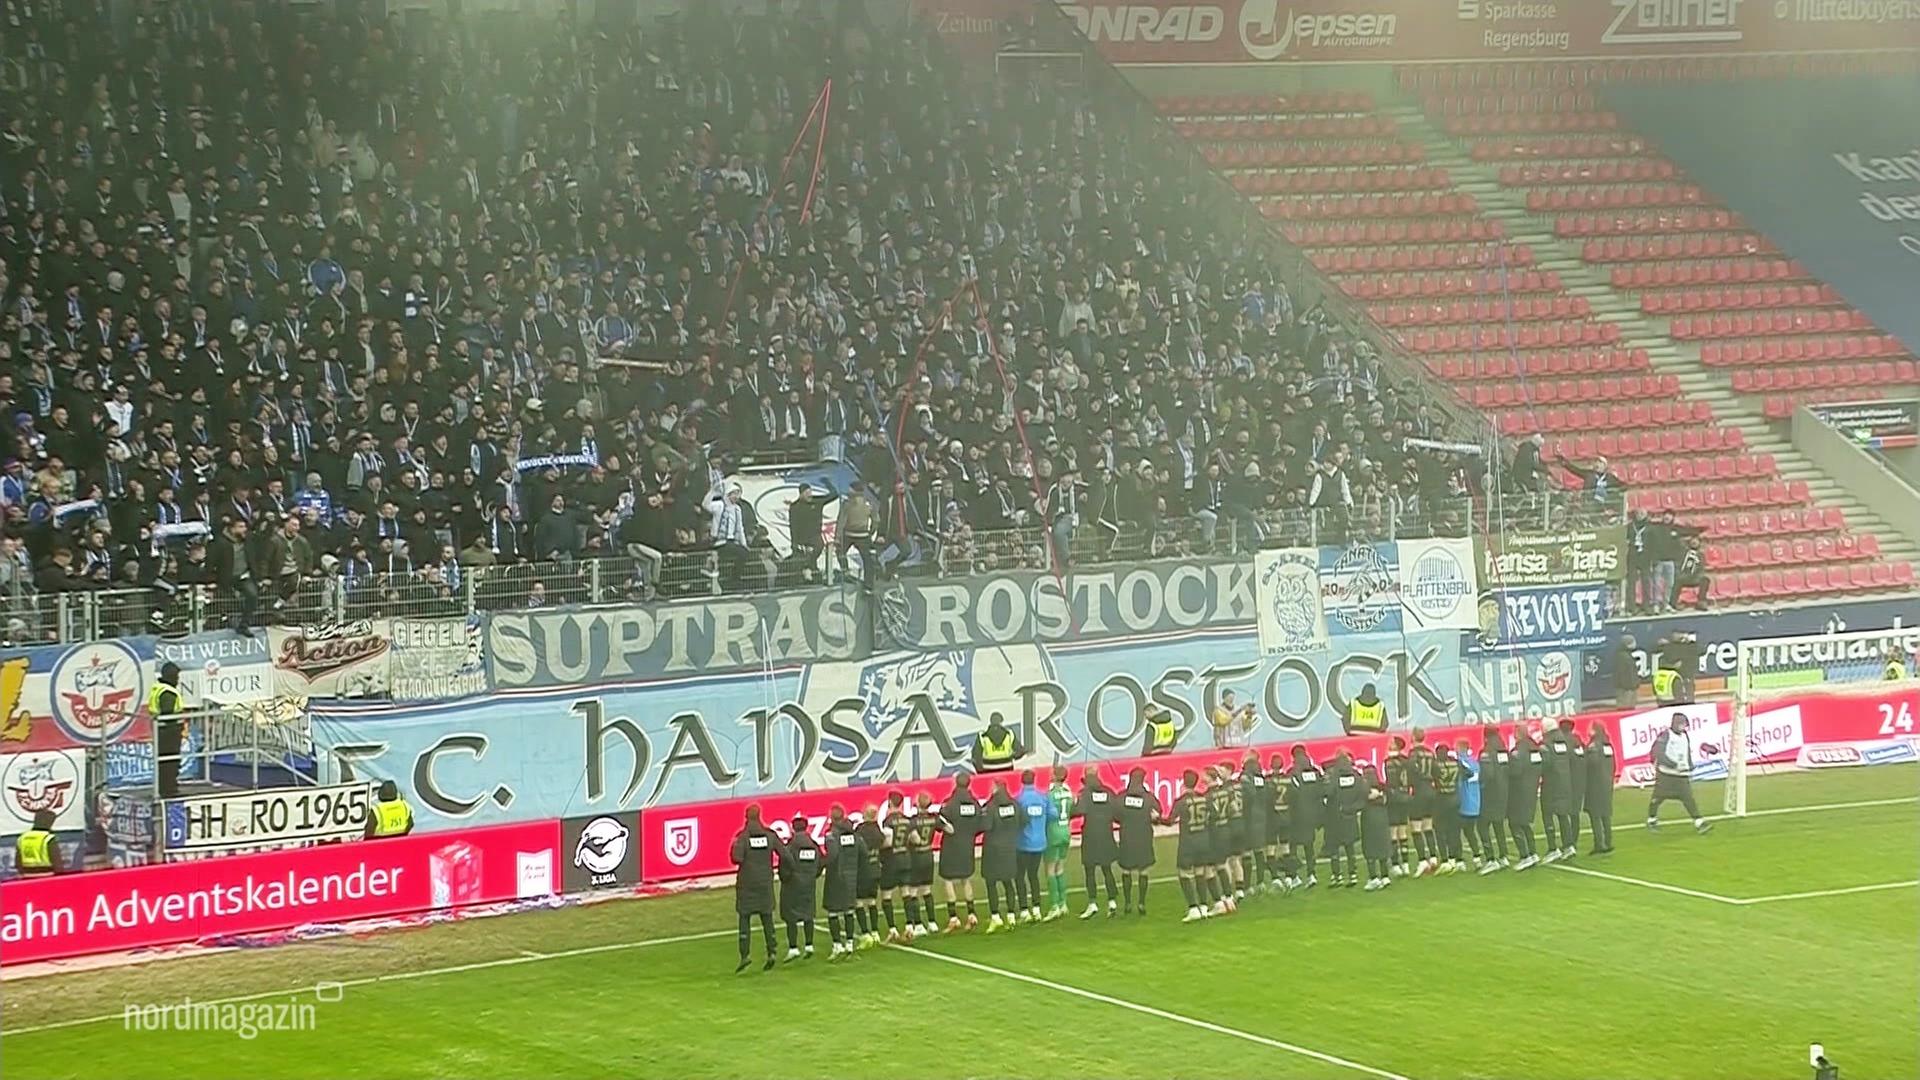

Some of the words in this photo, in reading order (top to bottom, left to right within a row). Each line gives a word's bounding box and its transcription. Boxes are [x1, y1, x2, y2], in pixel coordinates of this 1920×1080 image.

[1485, 1, 1557, 24] Sparkasse
[1483, 29, 1570, 51] Regensburg
[919, 564, 1256, 645] ROSTOCK
[1402, 581, 1472, 598] PLATTENBAU
[1504, 590, 1604, 637] REVOLTE
[393, 620, 466, 649] GEGEN
[490, 593, 857, 684] SUPTRAS
[207, 674, 262, 695] TOUR
[1459, 655, 1529, 707] NB
[1508, 699, 1577, 722] TOUR
[1877, 701, 1915, 735] 24
[171, 828, 183, 841] D
[187, 802, 229, 840] HH
[250, 798, 289, 834] RO
[294, 789, 370, 830] 1965
[87, 863, 404, 932] Adventskalender
